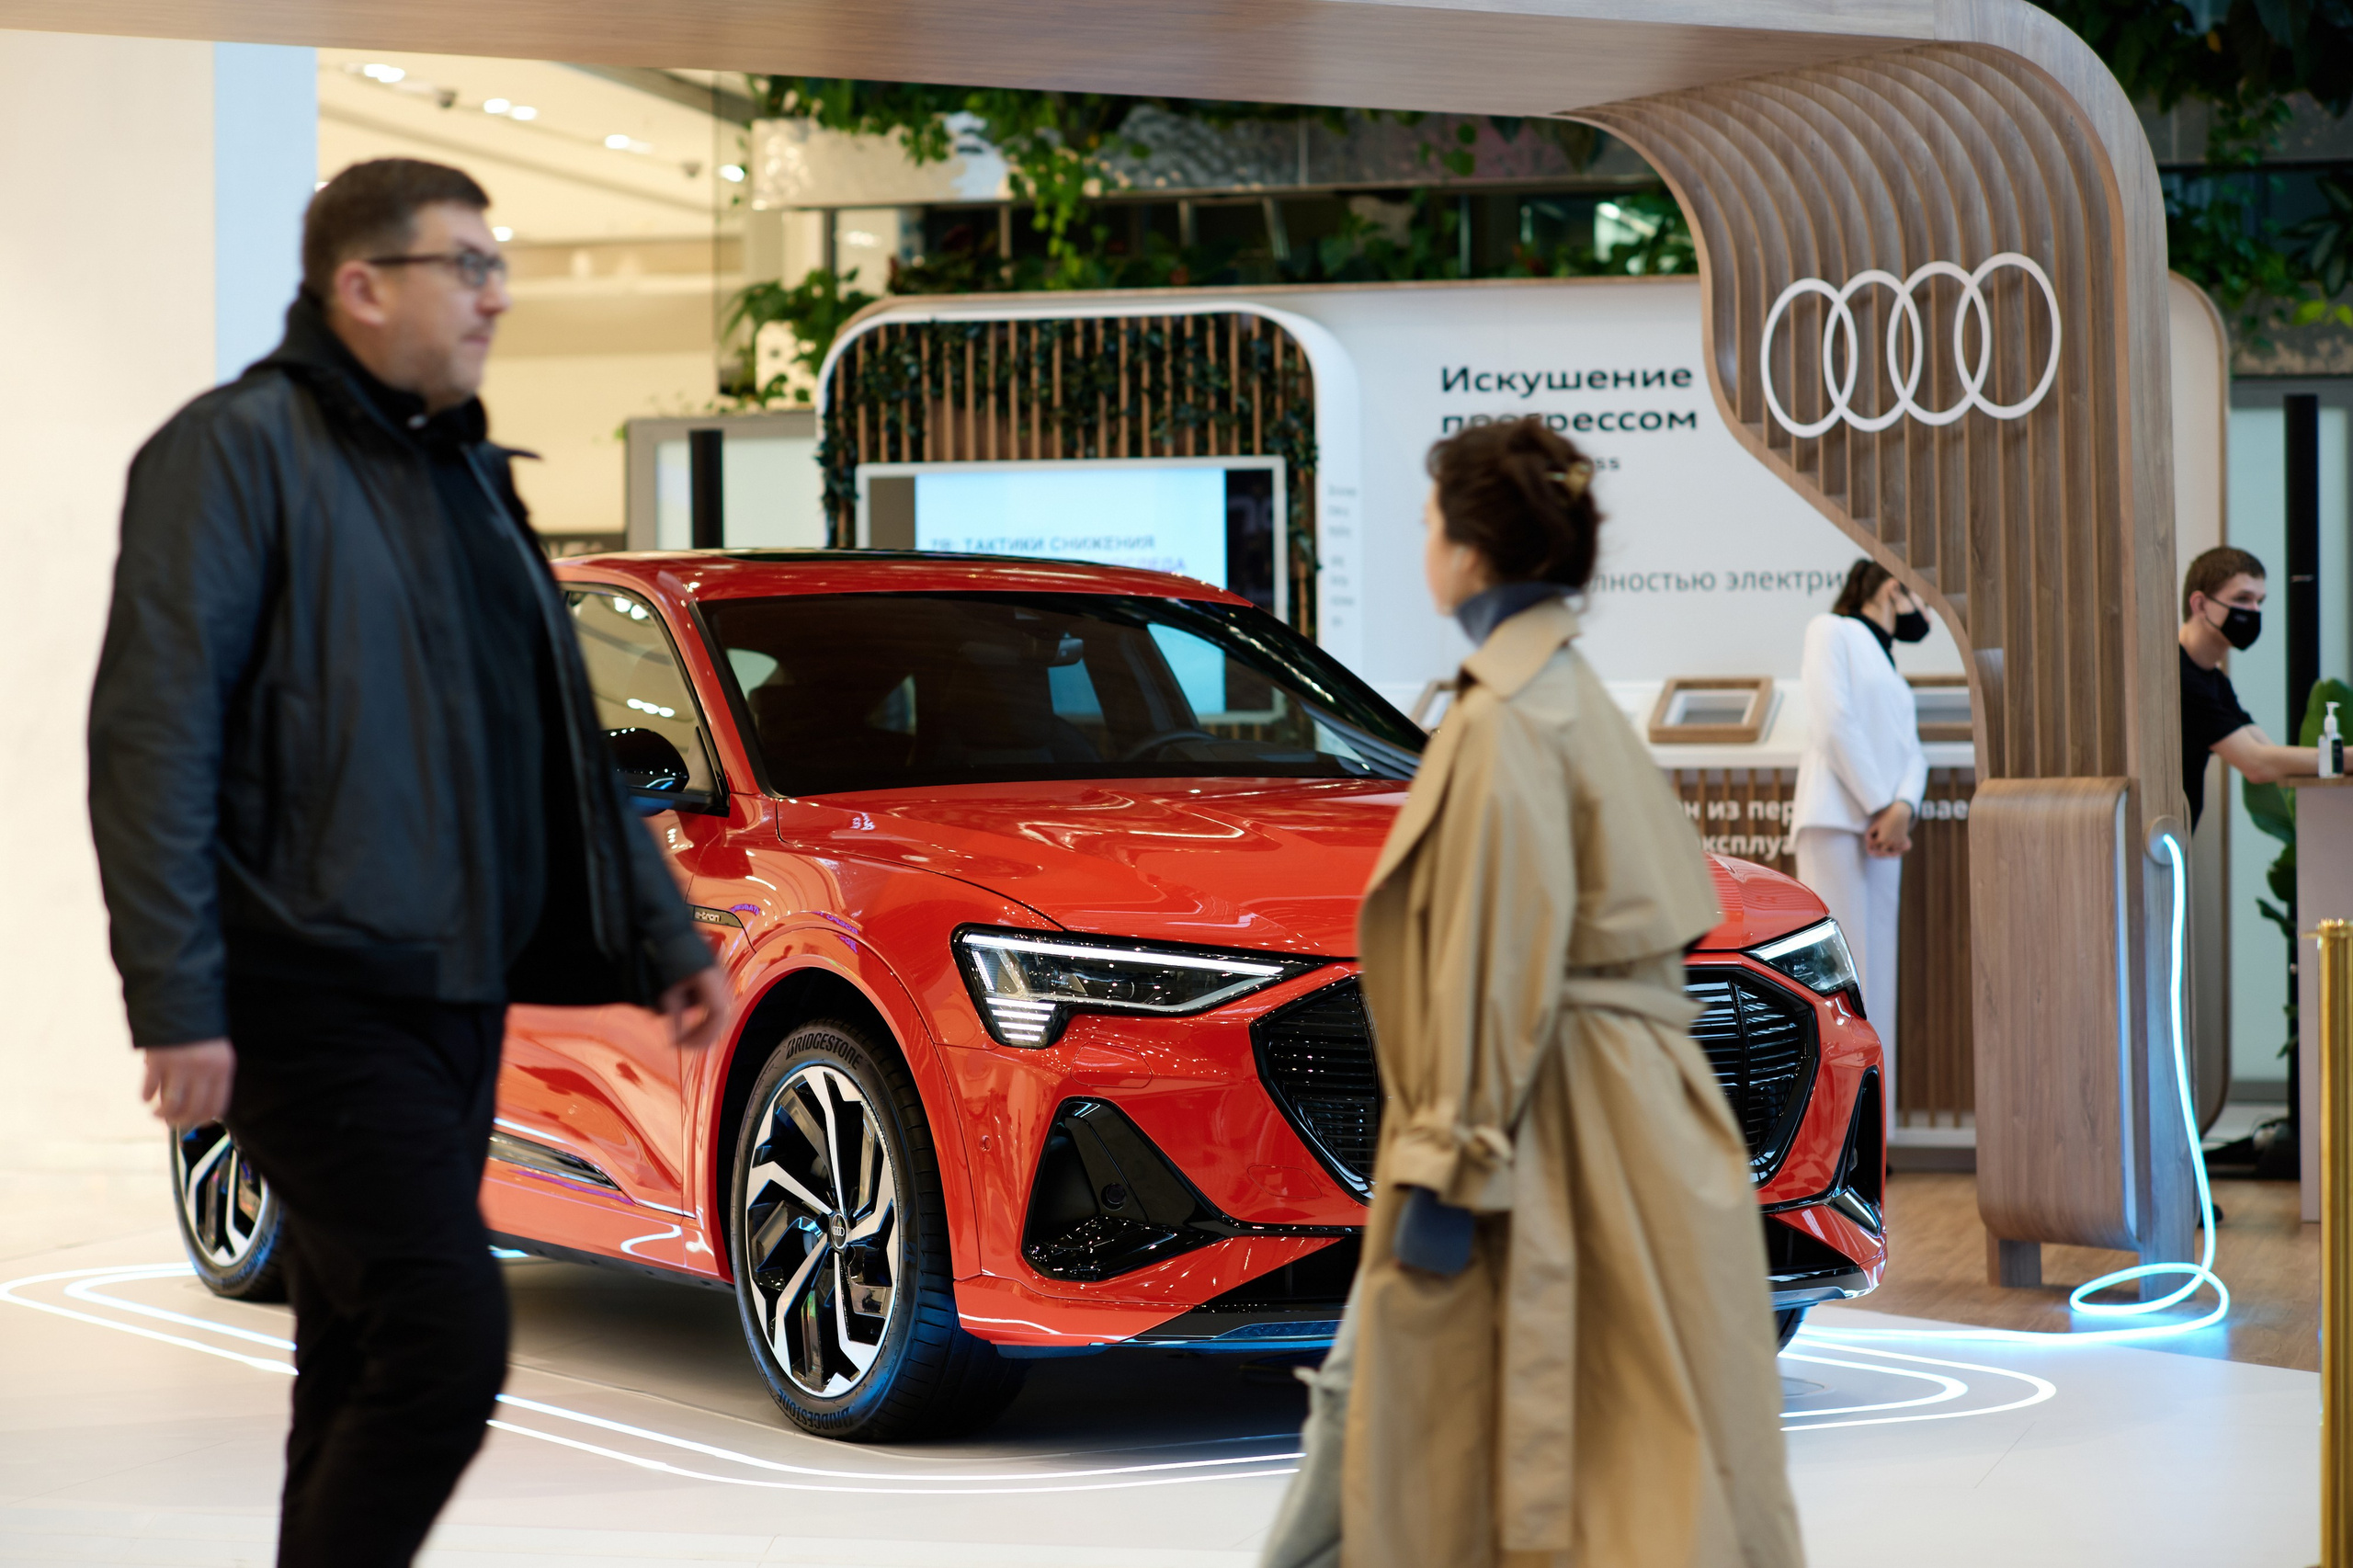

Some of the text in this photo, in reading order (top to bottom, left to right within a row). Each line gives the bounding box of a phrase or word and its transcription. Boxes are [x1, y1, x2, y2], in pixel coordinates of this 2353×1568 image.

[1441, 366, 1694, 400] Искушение
[1441, 411, 1698, 435] прессом
[1594, 567, 1844, 597] лностью электри
[1707, 800, 1740, 821] из
[1747, 800, 1793, 827] пер
[1701, 835, 1794, 862] ксплуа
[695, 912, 721, 923] e-tron
[786, 1032, 863, 1070] BRIDGESTONE
[778, 1388, 854, 1430] BRIDGESTONE
